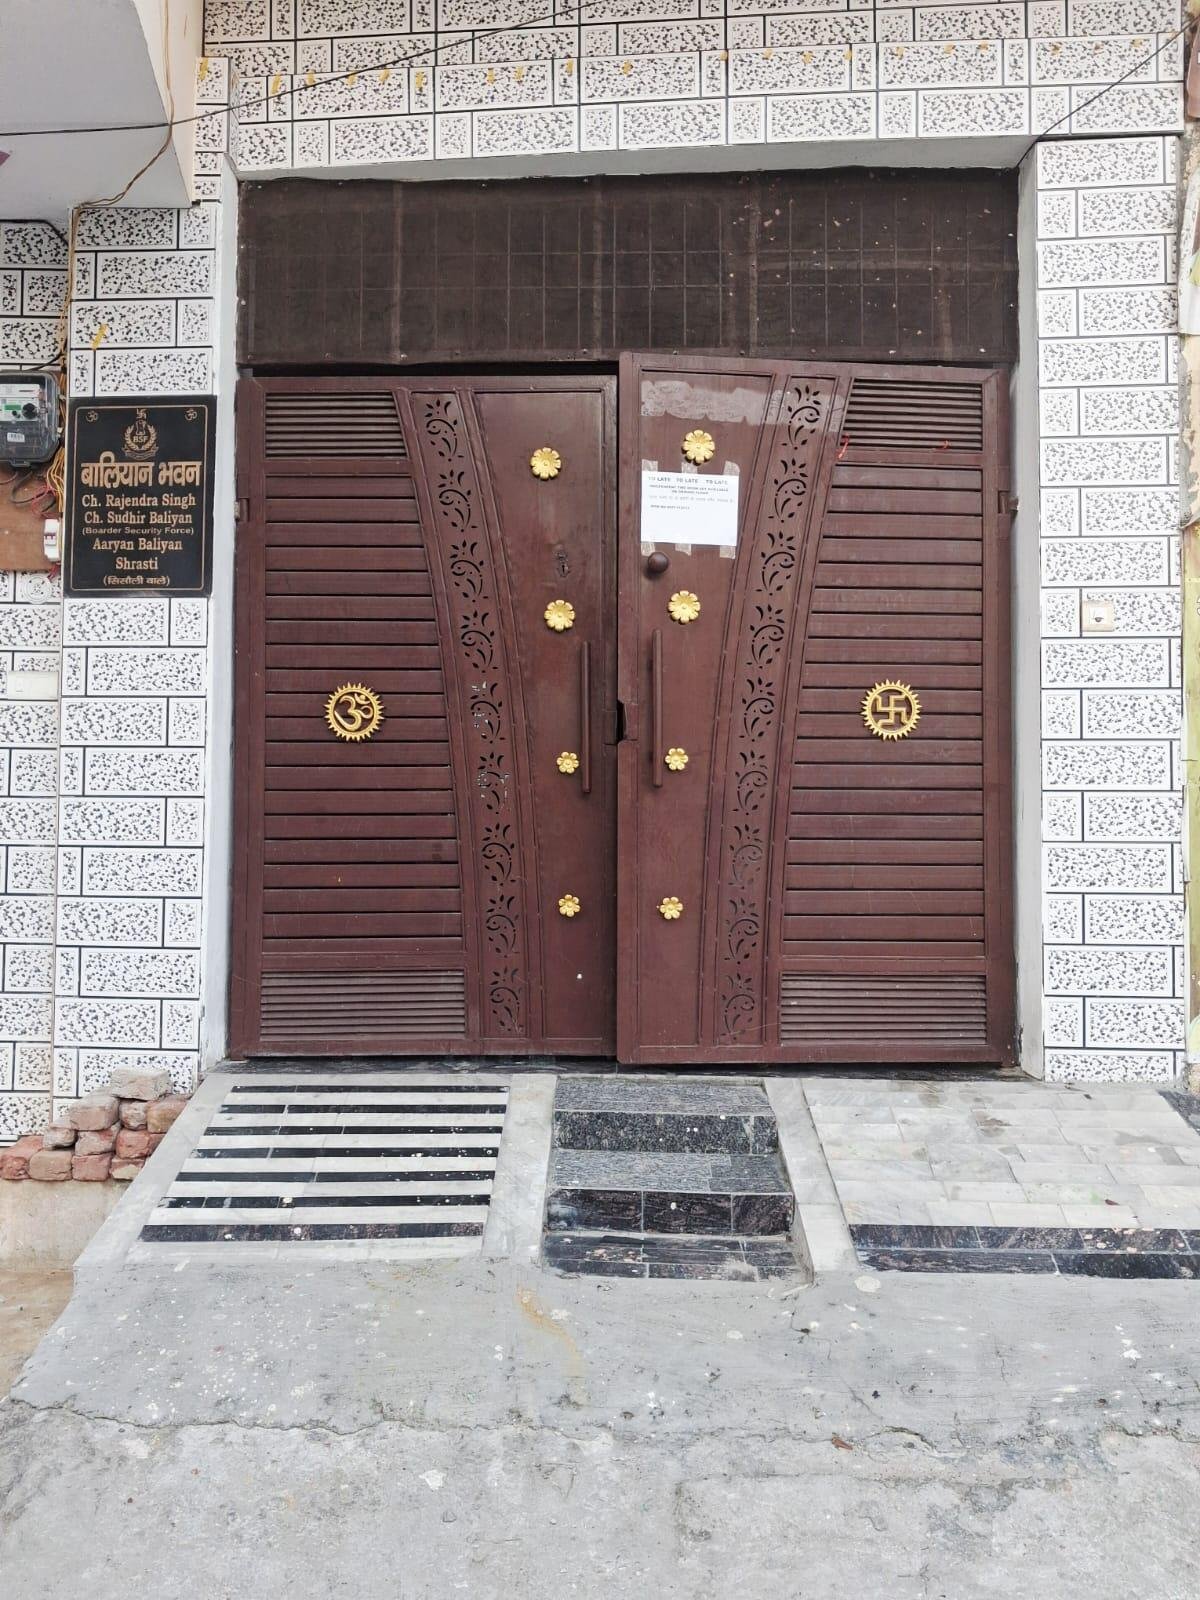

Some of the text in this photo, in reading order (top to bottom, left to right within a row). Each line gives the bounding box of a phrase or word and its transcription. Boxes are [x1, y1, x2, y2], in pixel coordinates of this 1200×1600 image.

[133, 435, 149, 443] BSF
[80, 451, 203, 489] बालियान भवन
[81, 493, 196, 510] Ch. Rajendra Singh
[84, 510, 193, 527] Ch. Sudhir Baliyan
[124, 526, 162, 535] Security
[164, 526, 194, 535] Force)
[93, 538, 183, 554] Aaryan Baliyan
[115, 556, 158, 570] Shrasti
